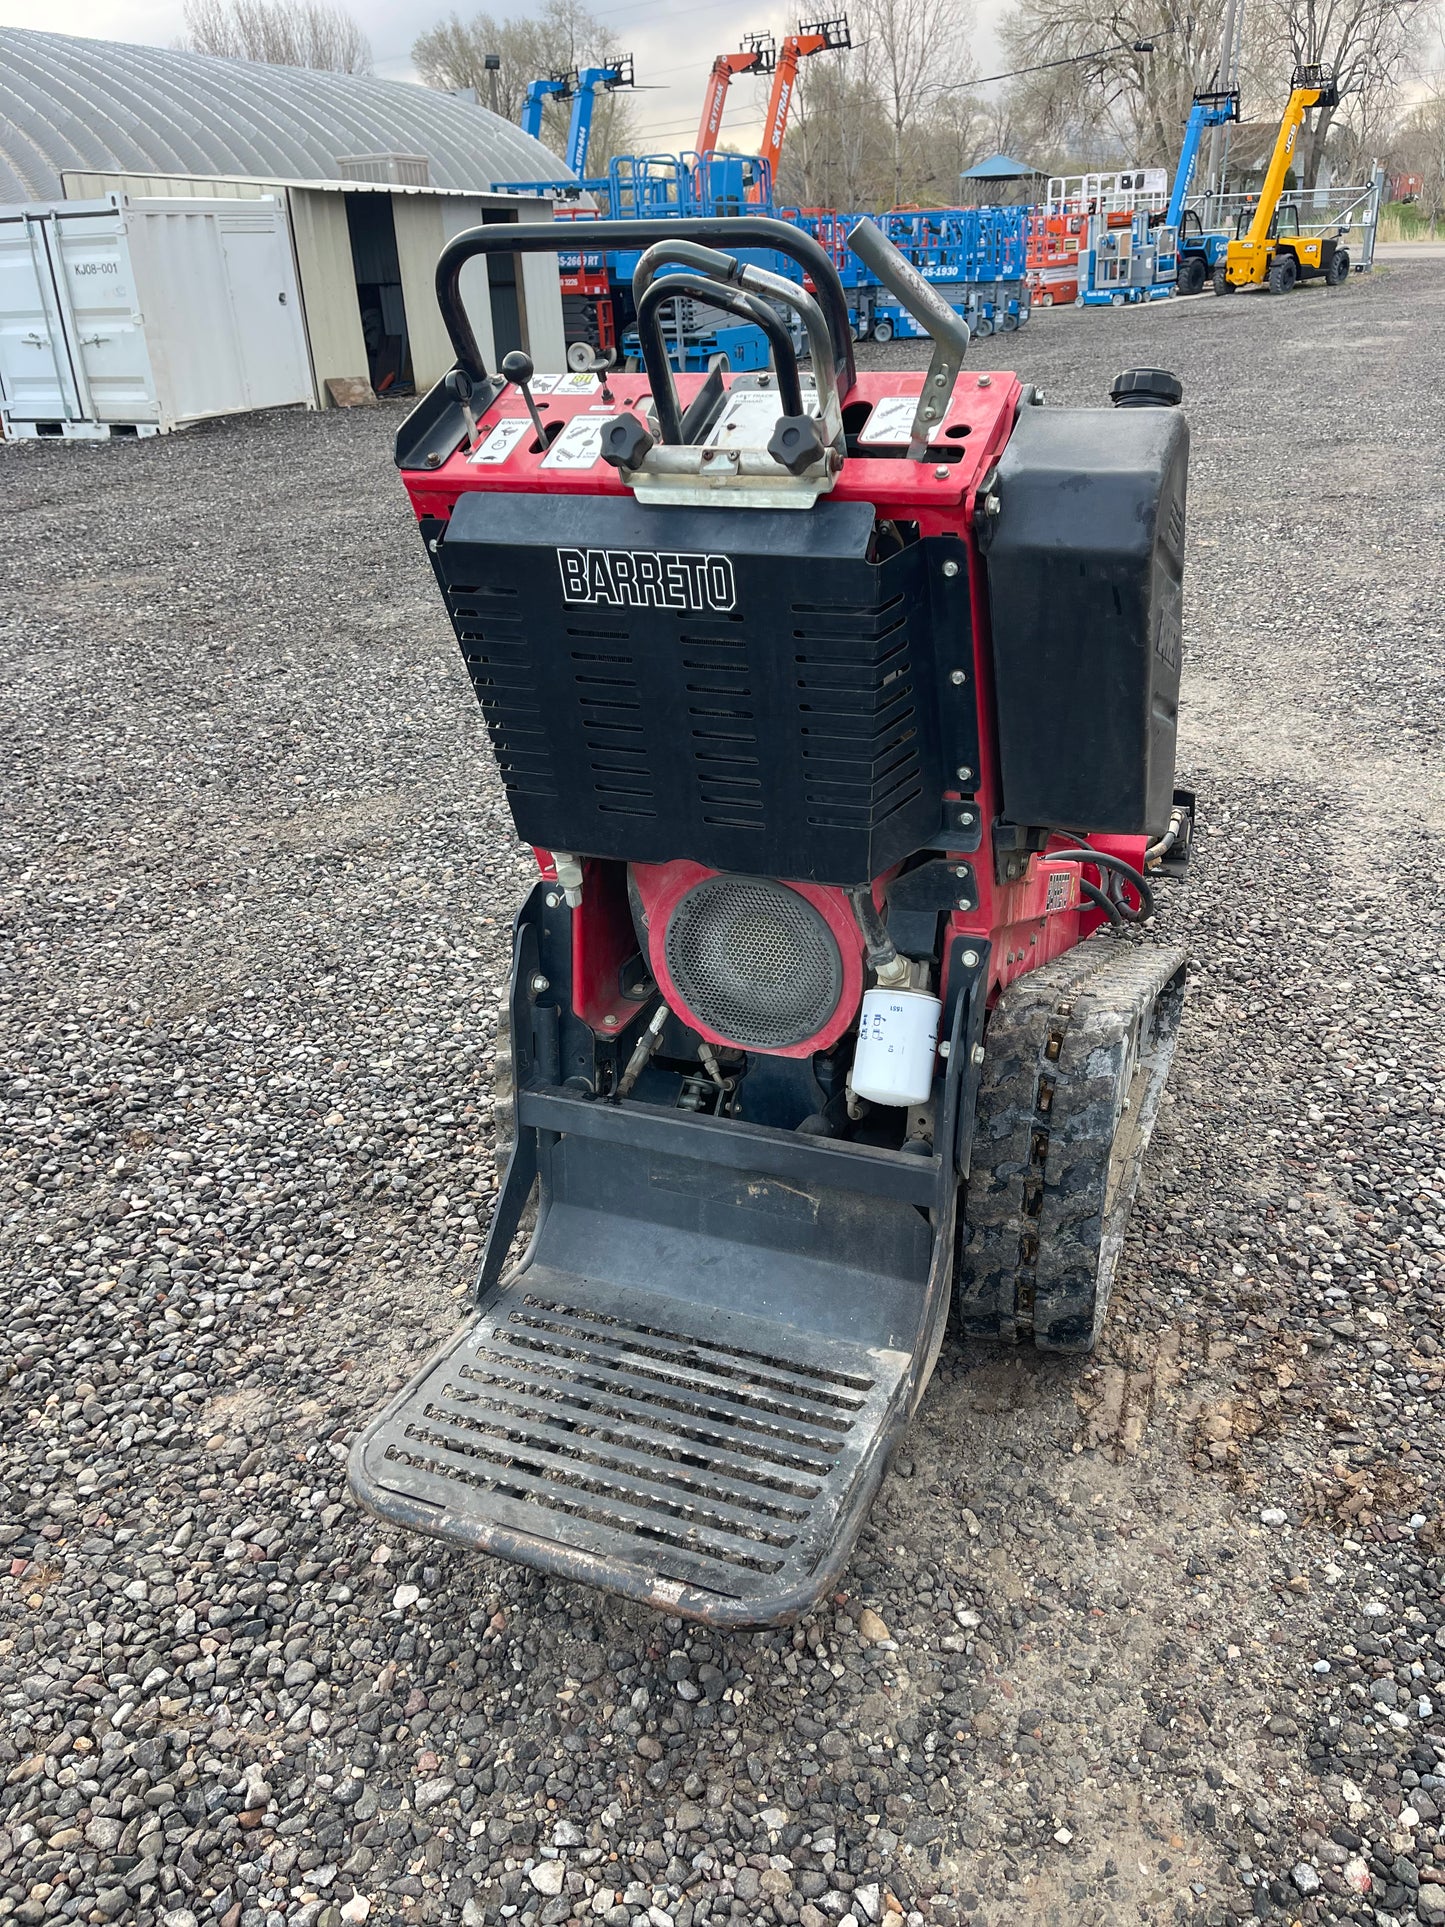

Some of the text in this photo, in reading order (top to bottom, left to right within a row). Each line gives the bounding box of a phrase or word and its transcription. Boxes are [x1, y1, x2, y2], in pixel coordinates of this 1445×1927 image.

[709, 82, 724, 133] SKYTRAK
[772, 80, 790, 149] SKYTRAK
[1285, 124, 1297, 153] JCB
[1215, 242, 1228, 252] Geni
[74, 262, 118, 275] KJ08-001
[588, 255, 599, 266] RT
[921, 266, 959, 277] GS-1930
[556, 548, 736, 611] BARRETO
